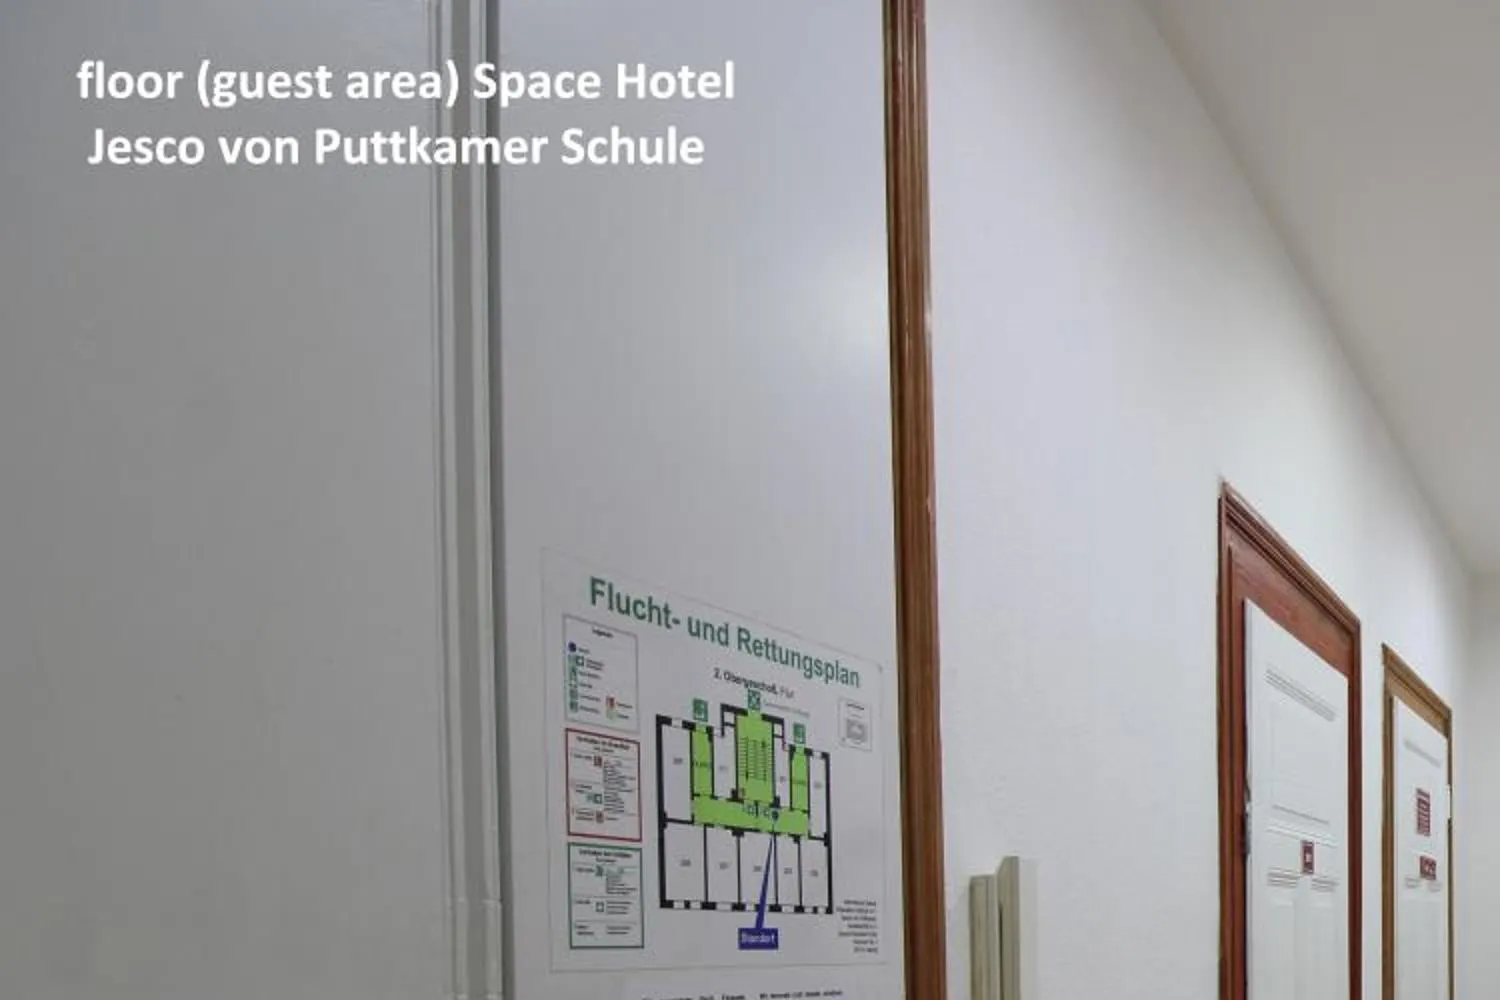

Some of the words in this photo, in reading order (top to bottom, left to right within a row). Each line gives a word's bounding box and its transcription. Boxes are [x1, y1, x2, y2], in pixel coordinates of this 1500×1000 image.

[590, 576, 681, 630] Flucht-
[687, 616, 730, 647] und
[736, 625, 861, 689] Rettungsplan
